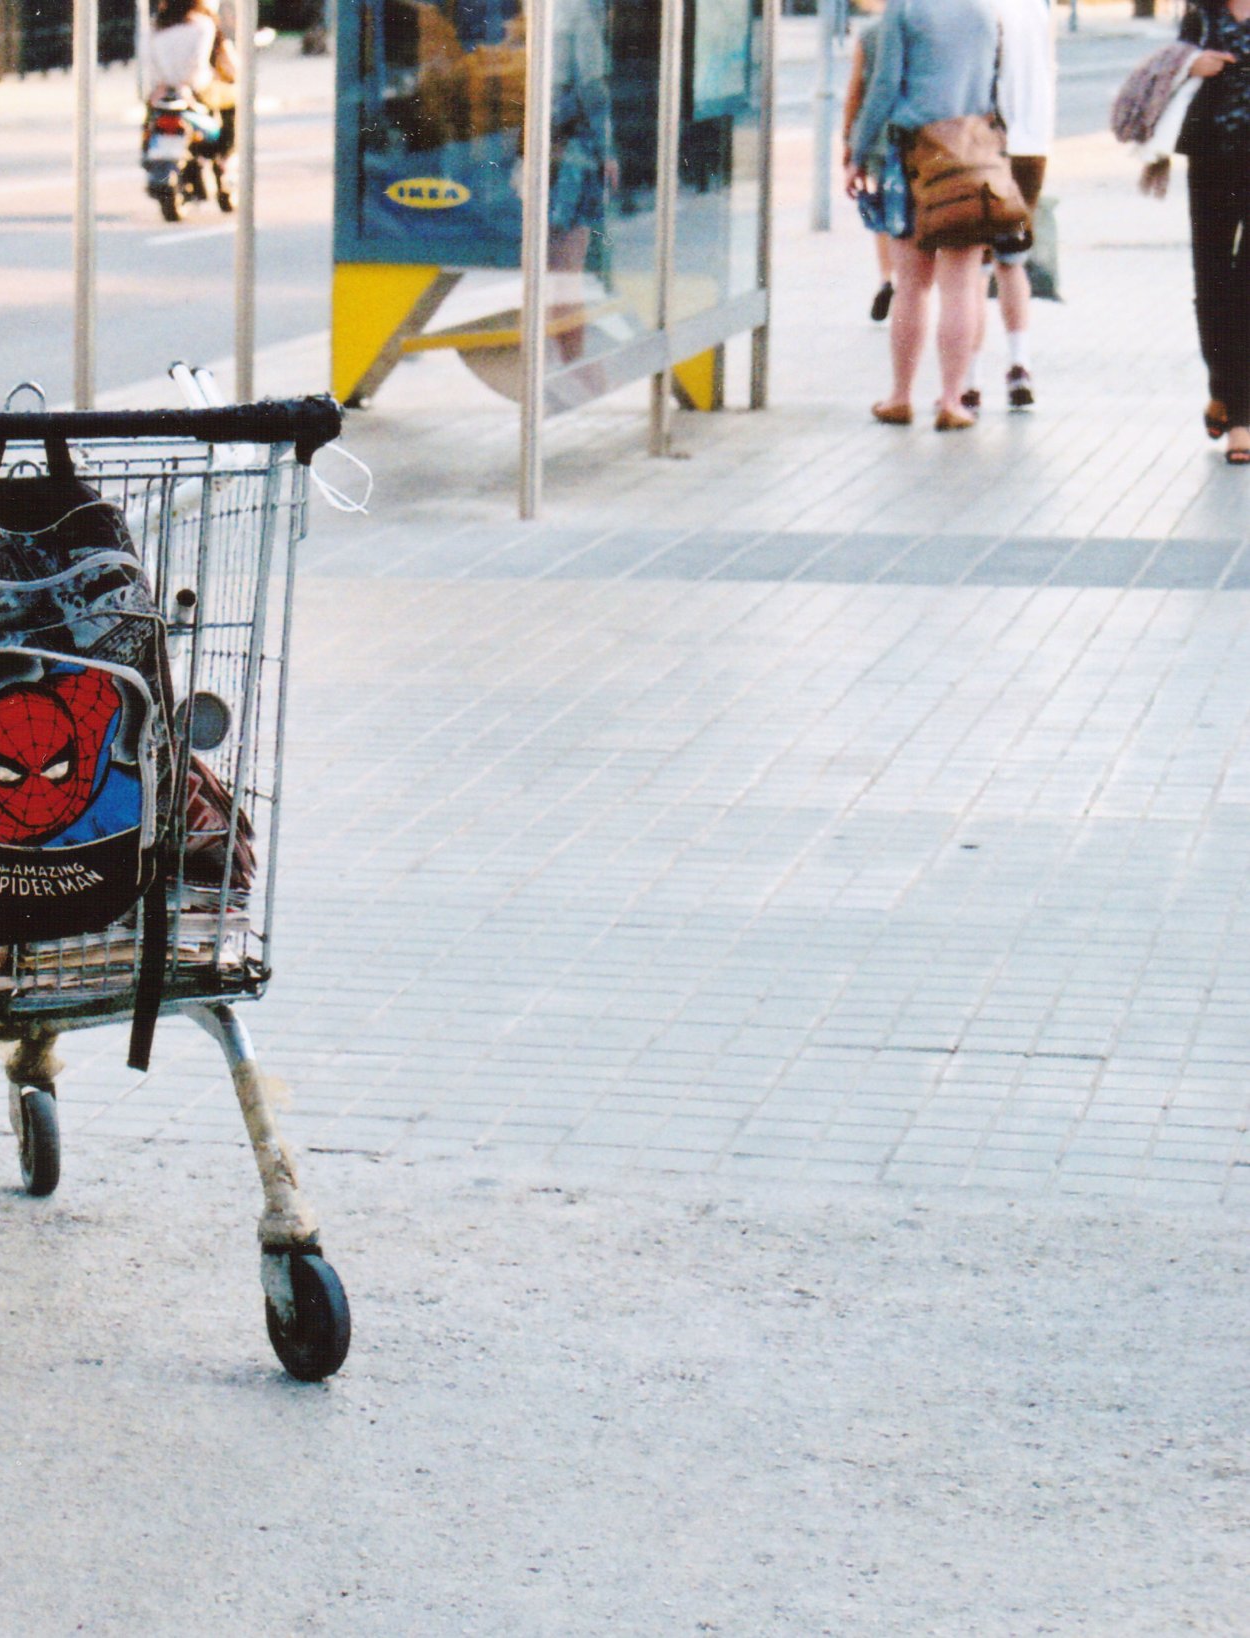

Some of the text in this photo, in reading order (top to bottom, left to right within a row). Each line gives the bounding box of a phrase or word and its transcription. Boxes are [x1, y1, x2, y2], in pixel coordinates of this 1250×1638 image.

[397, 186, 460, 200] IKEA
[12, 862, 85, 878] AMAZING
[57, 869, 104, 895] MAN
